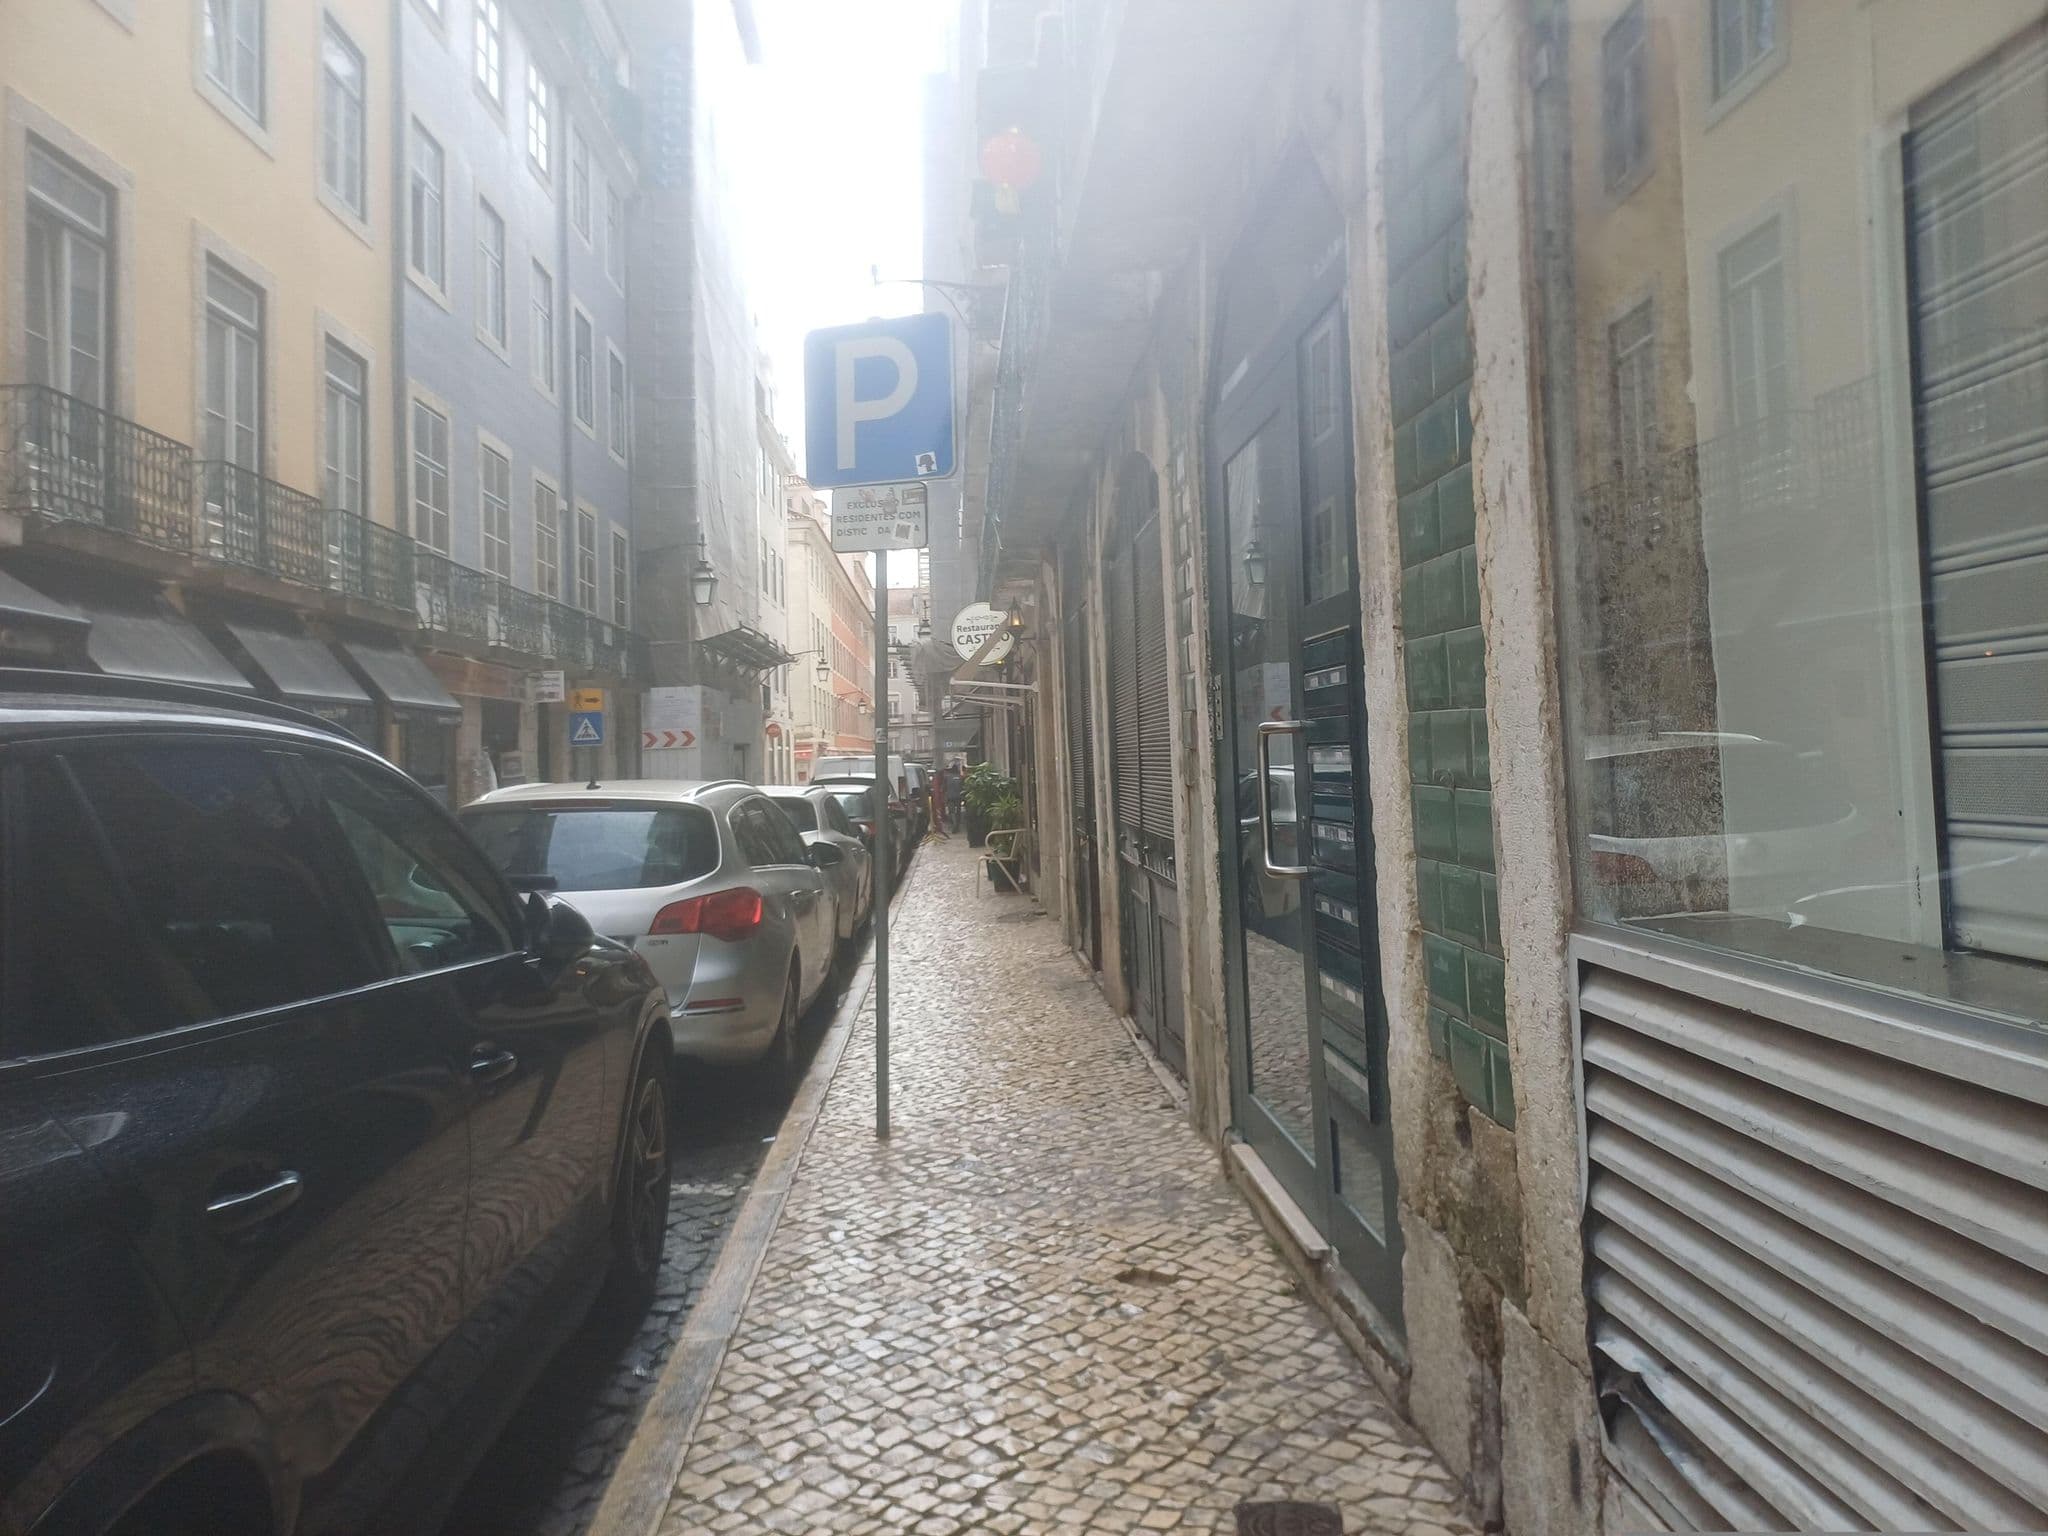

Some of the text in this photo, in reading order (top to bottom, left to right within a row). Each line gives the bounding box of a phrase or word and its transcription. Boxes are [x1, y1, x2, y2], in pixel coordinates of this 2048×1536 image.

[836, 336, 919, 469] P
[837, 511, 920, 523] RESIDENTES COM
[878, 526, 890, 535] DA
